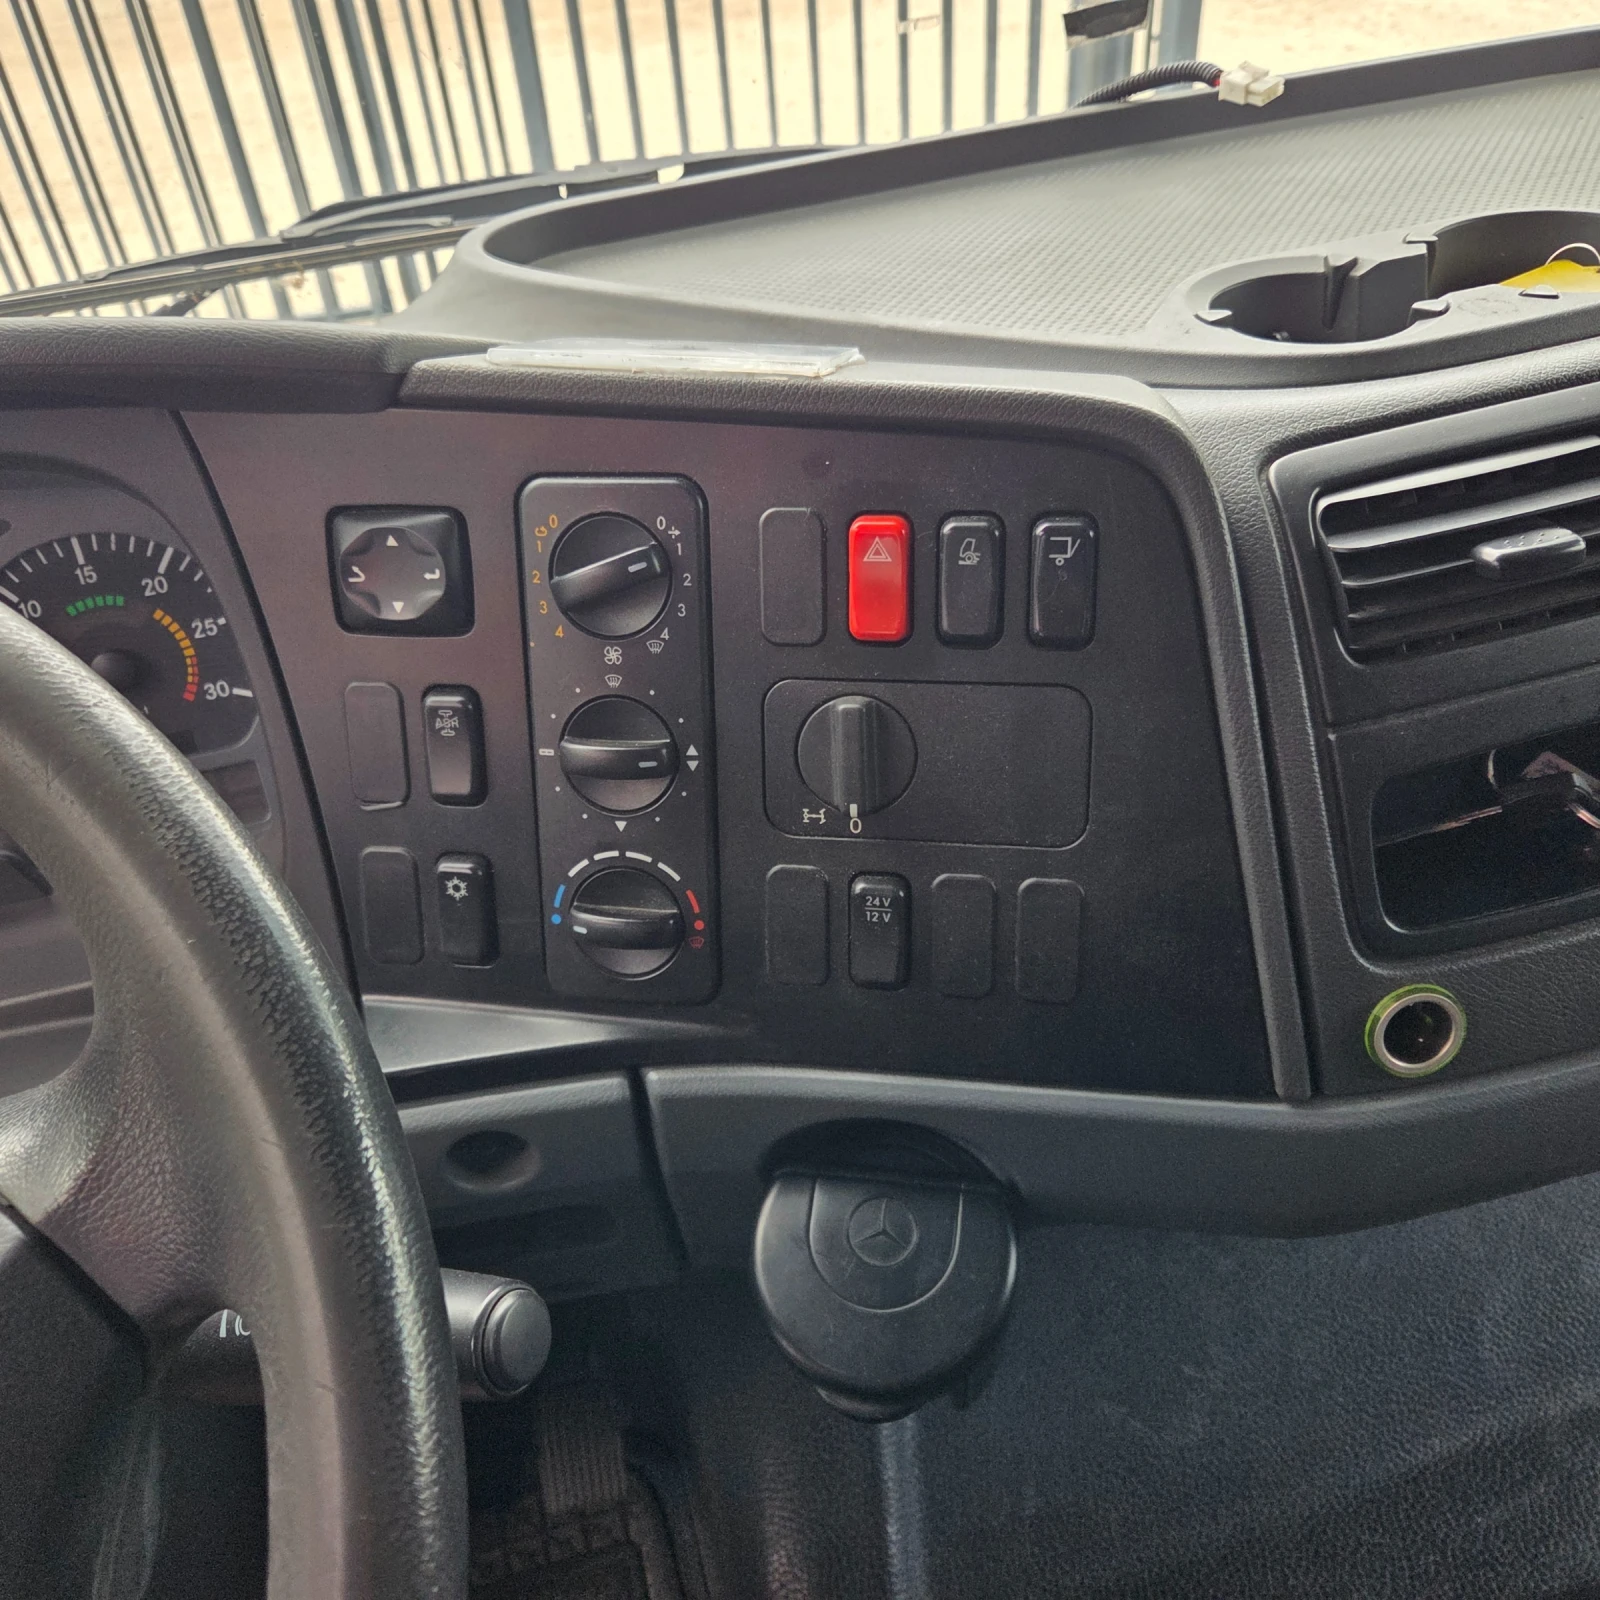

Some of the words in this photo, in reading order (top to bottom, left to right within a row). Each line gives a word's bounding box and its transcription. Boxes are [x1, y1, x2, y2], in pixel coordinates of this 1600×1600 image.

[549, 514, 558, 529] 0
[657, 516, 666, 530] 0
[74, 566, 98, 585] 15
[532, 571, 541, 584] 2
[683, 574, 692, 586] 2
[141, 576, 169, 597] 20
[19, 600, 42, 618] 10
[539, 601, 548, 614] 3
[677, 604, 686, 616] 3
[191, 618, 219, 639] 25
[555, 625, 565, 638] 4
[660, 628, 669, 640] 4
[203, 680, 230, 701] 30
